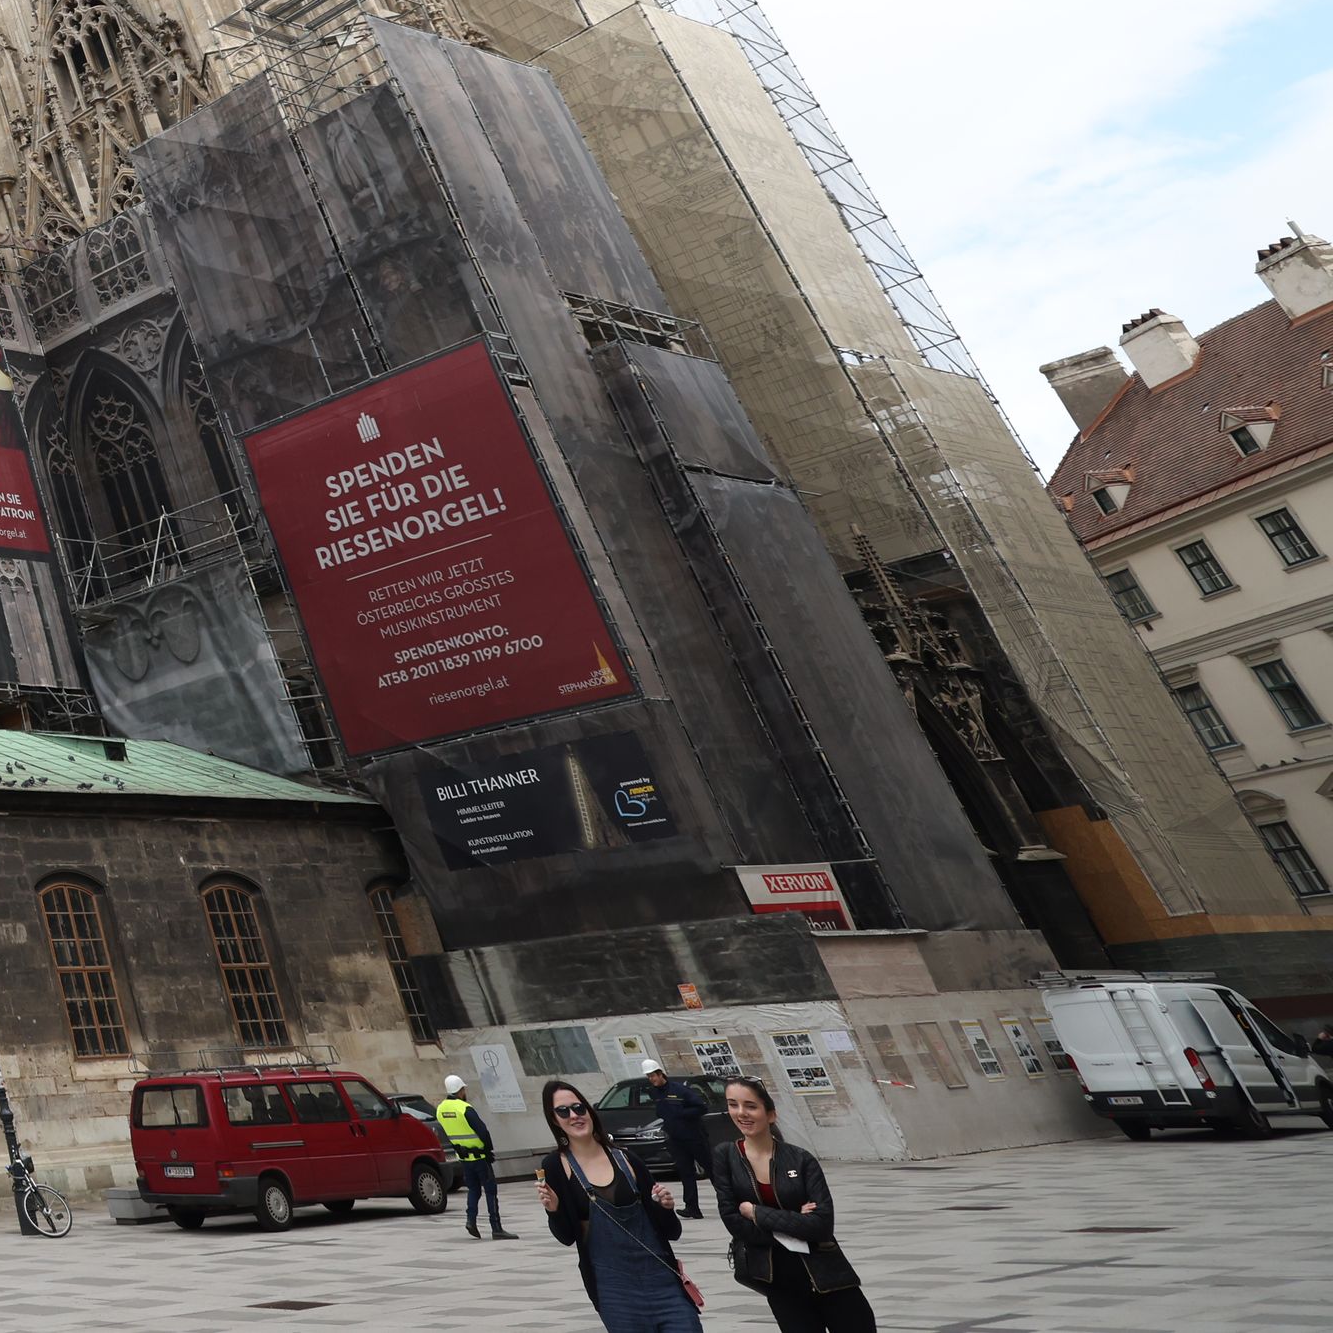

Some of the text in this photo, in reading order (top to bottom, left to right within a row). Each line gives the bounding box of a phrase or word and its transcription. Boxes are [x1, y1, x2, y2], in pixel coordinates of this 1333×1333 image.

[326, 437, 444, 497] SPENDEN
[6, 493, 22, 505] SIE
[326, 464, 469, 532] SIE FÜR DIE
[315, 488, 507, 569] RIESENORGEL!
[369, 558, 484, 602] RETTEN WIR JETZT
[357, 570, 515, 625] ÖSTERREICHS GRÖSSTES
[380, 594, 501, 639] MUSIKINSTRUMENT
[394, 625, 509, 664] SPENDENKONTO:
[378, 635, 543, 688] AT58 2011 1839 1199 6700
[429, 675, 509, 705] riesenorgel.at
[558, 675, 614, 694] STEPHANSDOM
[437, 769, 540, 801] BILLI THANNER
[620, 778, 642, 788] powered
[456, 801, 505, 816] HIMMELSLEITER
[468, 829, 534, 846] KUNSTINSTALLATION
[764, 874, 827, 891] XERVON
[806, 916, 837, 930] tbau
